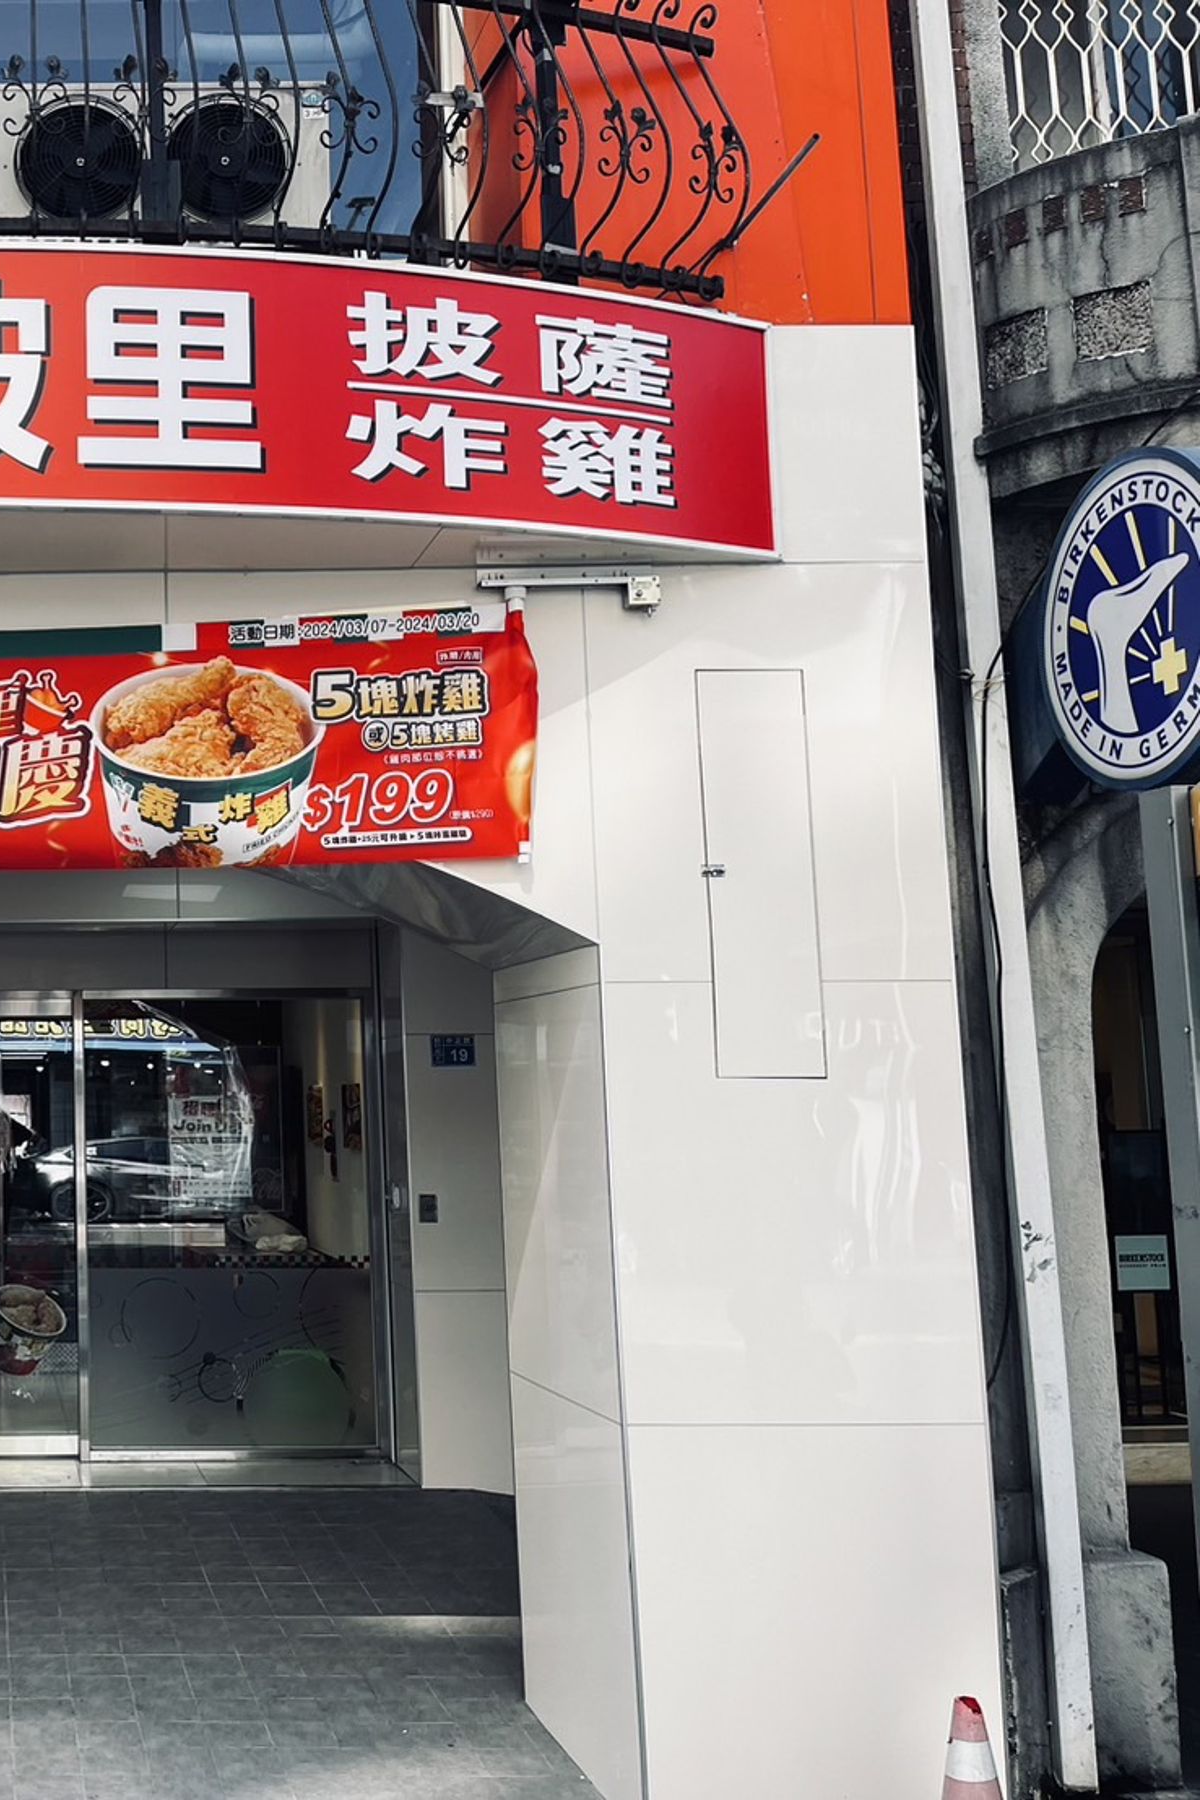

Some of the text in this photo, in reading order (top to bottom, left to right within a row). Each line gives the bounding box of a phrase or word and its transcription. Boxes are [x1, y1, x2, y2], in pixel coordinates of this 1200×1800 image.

[346, 290, 675, 410] 披薩
[345, 399, 679, 509] 炸雞
[1057, 479, 1200, 604] BIRKENSTOCK
[314, 670, 485, 719] 5塊炸雞
[1054, 652, 1092, 740] MADE
[1099, 738, 1123, 761] IN
[301, 768, 454, 831] $199
[450, 1048, 468, 1062] 19
[173, 1119, 212, 1133] Join
